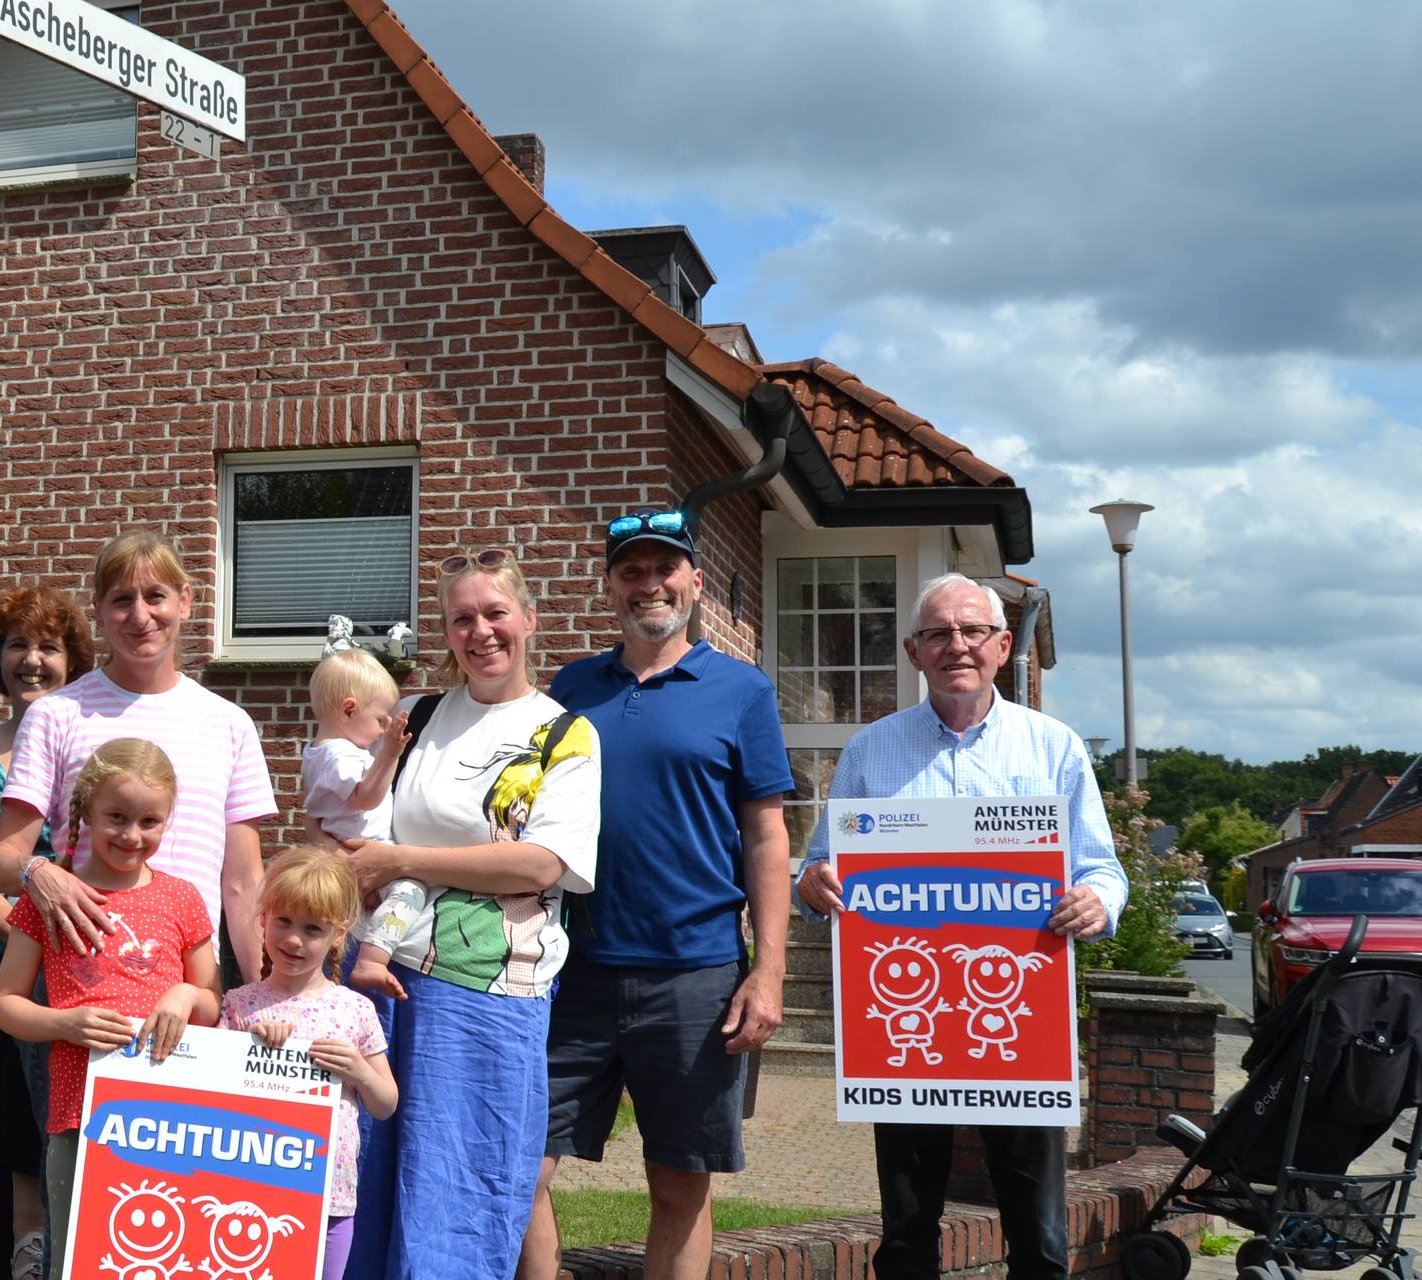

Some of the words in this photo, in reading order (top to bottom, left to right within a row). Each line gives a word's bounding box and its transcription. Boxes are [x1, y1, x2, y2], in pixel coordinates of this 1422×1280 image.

[0, 0, 156, 87] Ascheberger
[166, 58, 238, 125] Straße
[164, 115, 184, 144] 22
[209, 134, 215, 156] 1
[879, 813, 920, 822] POLIZEI
[974, 805, 1058, 818] ANTENNE
[974, 817, 1058, 831] MÜNSTER
[974, 837, 995, 845] 95.4
[998, 837, 1020, 845] MHz
[847, 882, 1053, 912] ACHTUNG!
[247, 1045, 315, 1065] ANTEN
[245, 1060, 332, 1082] MÜNSTER
[243, 1079, 265, 1089] 95.4
[267, 1081, 291, 1093] MHz
[844, 1087, 903, 1106] KIDS
[912, 1089, 1073, 1109] UNTERWEGS
[97, 1113, 316, 1172] ACHTUNG!
